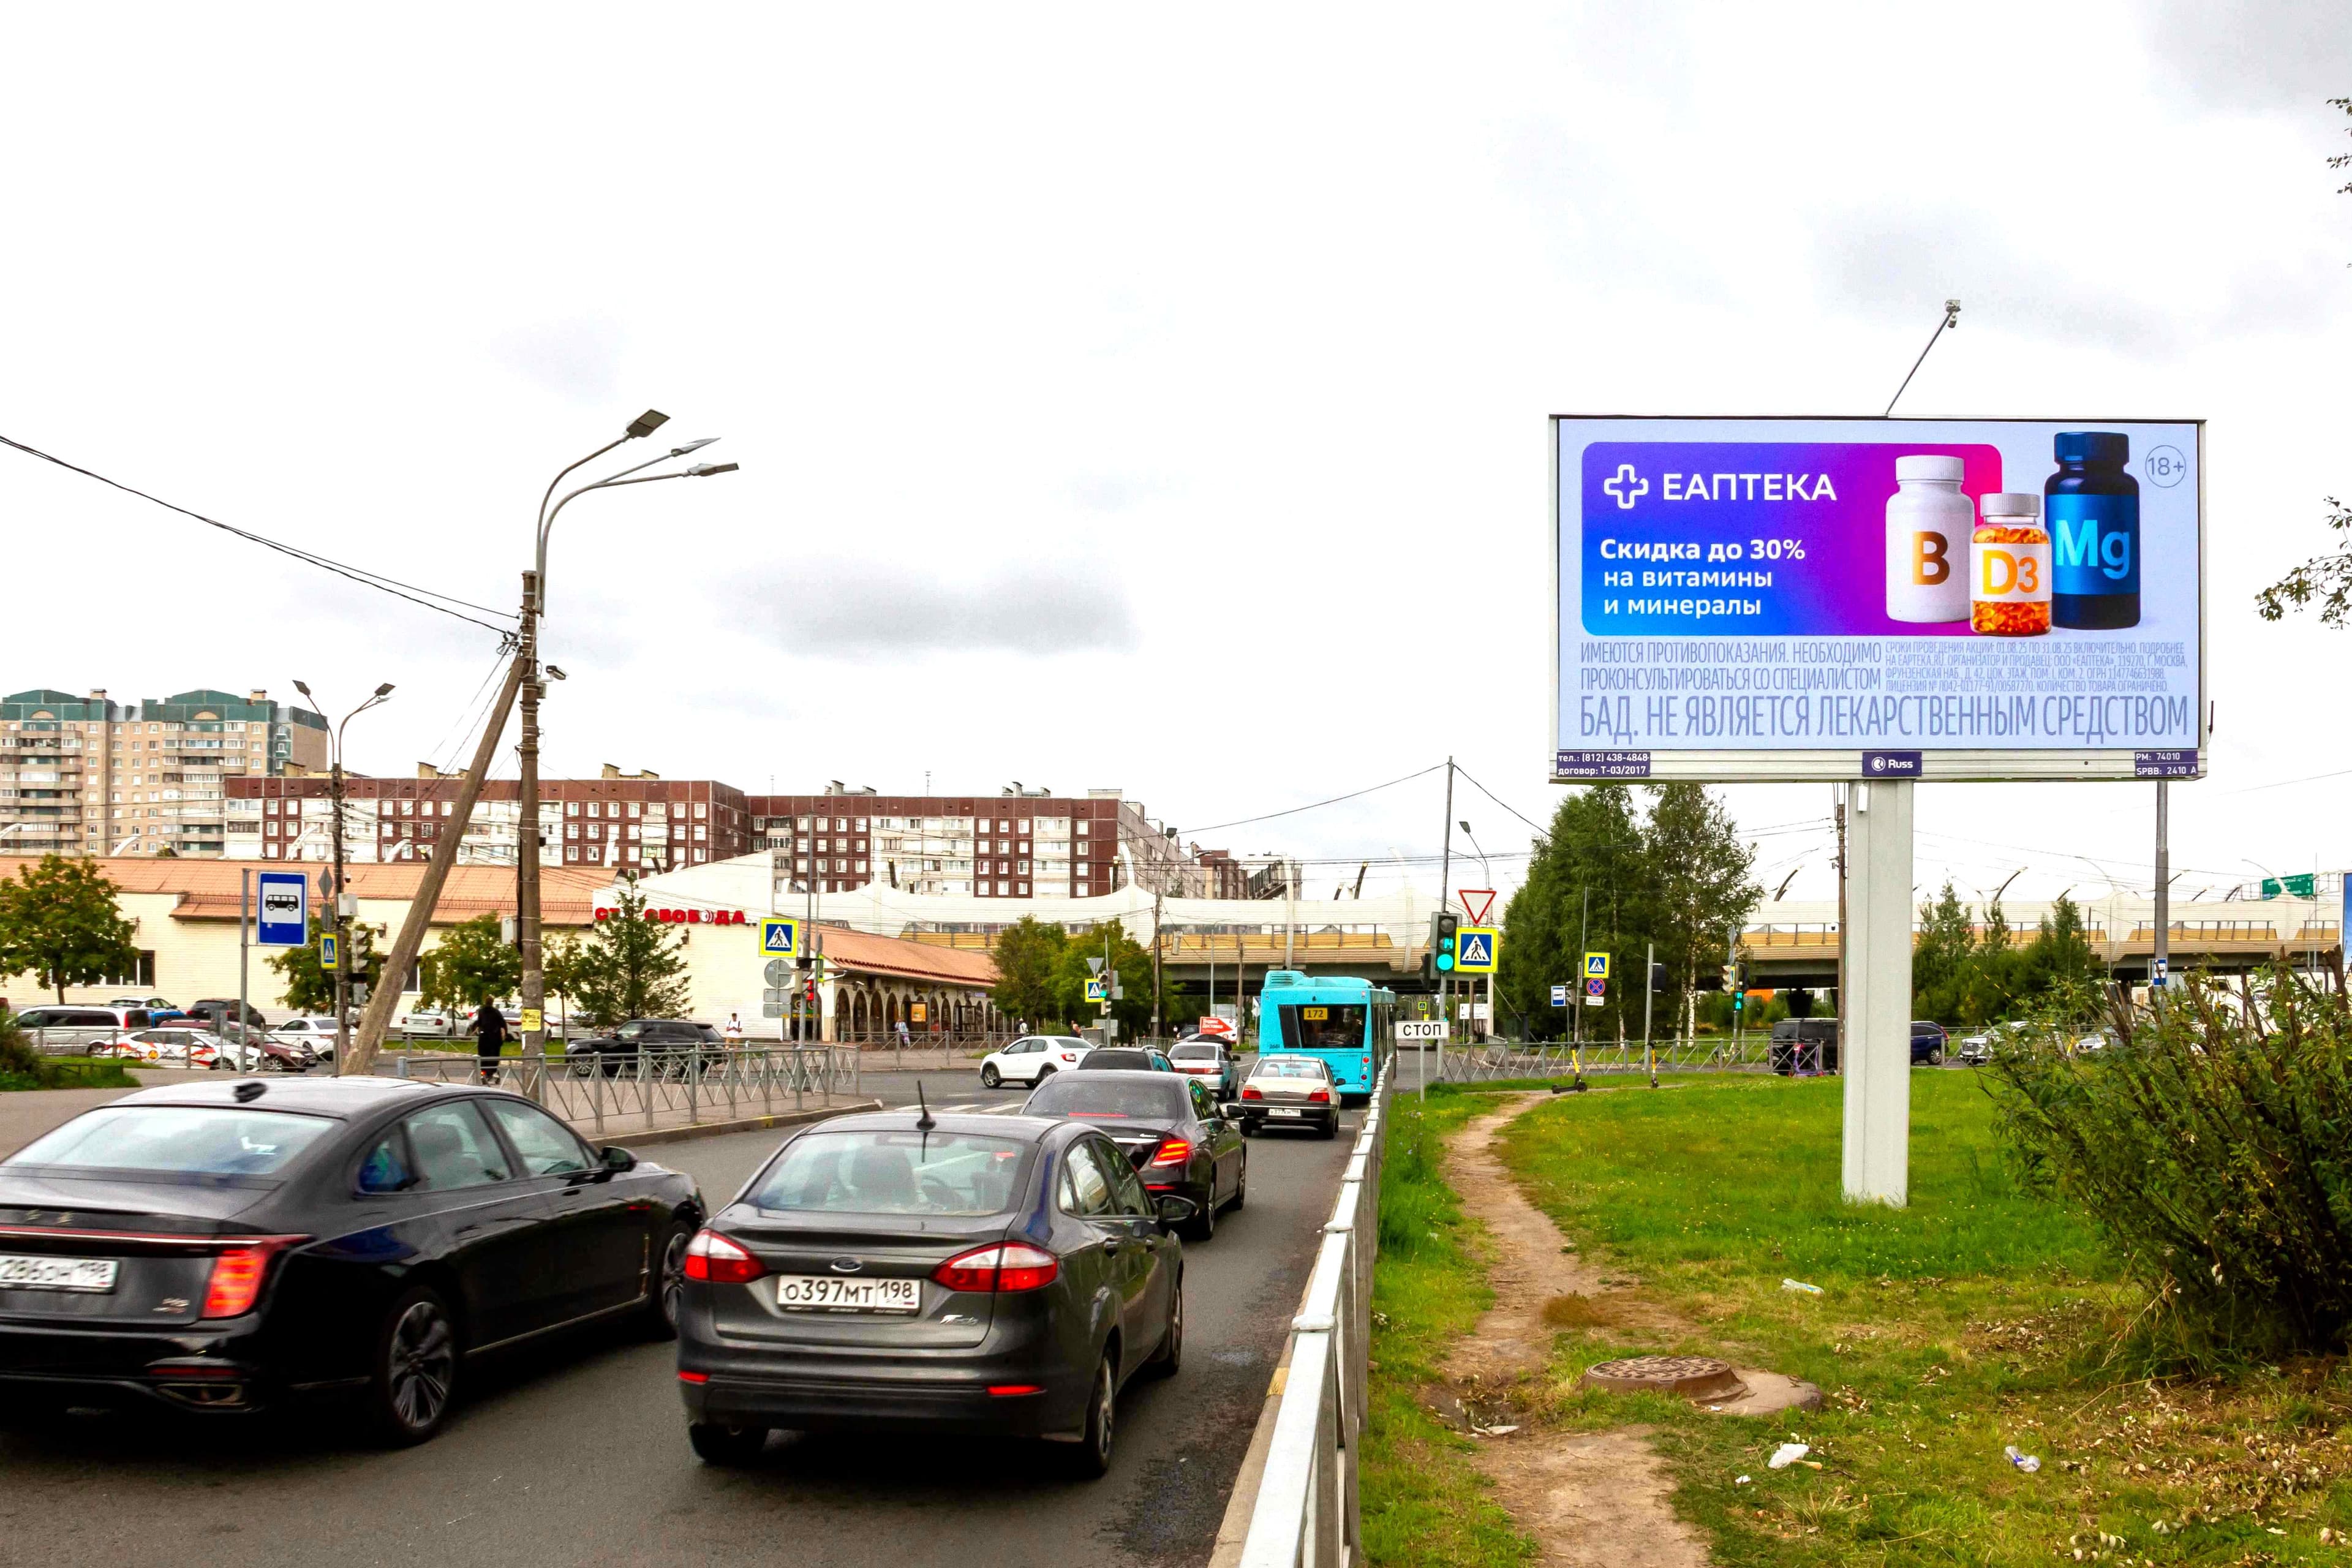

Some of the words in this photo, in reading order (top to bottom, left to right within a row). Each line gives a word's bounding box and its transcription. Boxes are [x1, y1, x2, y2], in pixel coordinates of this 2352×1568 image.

[2147, 457, 2184, 476] 18+
[1663, 473, 1837, 500] ЕАПТЕКА
[1600, 539, 1700, 562] Скидка
[1708, 543, 1742, 562] до
[1750, 539, 1806, 560] 30%
[1912, 530, 1950, 585] B
[2055, 519, 2130, 581] Mg
[1604, 571, 1634, 587] на
[1643, 571, 1772, 587] витамины
[1982, 549, 2038, 595] D3
[1604, 599, 1619, 614] и
[1627, 599, 1762, 619] минералы
[1581, 642, 1643, 663] ИМЕЮТСЯ
[1647, 642, 1789, 663] ПРОТИВОПОКАЗАНИЯ.
[1793, 642, 1881, 667] НЕОБХОДИМО
[1886, 642, 1911, 654] СРОКИ
[1913, 642, 1964, 655] ПРОВЕДЕНИЯ
[2029, 642, 2040, 654] ПО
[2139, 642, 2185, 656] ПОДРОБНЕЕ
[1886, 654, 1897, 666] НА
[1948, 654, 2000, 666] ОРГАНИЗАТОР
[2002, 655, 2008, 666] И
[2054, 655, 2070, 667] ООО
[1886, 667, 1942, 679] ФРУНЗЕНСКАЯ
[2087, 668, 2106, 679] ОГРН
[1581, 668, 1750, 690] ПРОКОНСУЛЬТИРОВАТЬСЯ
[1754, 668, 1770, 690] СО
[1773, 668, 1881, 695] СПЕЦИАЛИСТОМ
[1886, 680, 1927, 693] ЛИЦЕНЗИЯ
[2037, 680, 2086, 692] КОЛИЧЕСТВО
[2088, 680, 2116, 692] ТОВАРА
[1580, 696, 1638, 745] БАД.
[1646, 696, 1678, 736] НЕ
[1685, 696, 1809, 736] ЯВЛЯЕТСЯ
[1817, 696, 2035, 736] ЛЕКАРСТВЕННЫМ
[2043, 695, 2187, 744] СРЕДСТВОМ
[1582, 753, 1604, 763] (812)
[1606, 753, 1648, 762] 438-4848
[1888, 759, 1913, 769] Russ
[2156, 752, 2180, 761] 74010
[1558, 767, 1598, 776] договор:
[1600, 766, 1646, 775] Т-03/2017
[2136, 767, 2162, 775] SPBB:
[2166, 766, 2187, 775] 2410
[2190, 766, 2197, 774] A
[1307, 1009, 1324, 1018] 172
[1403, 1024, 1441, 1036] СТОП
[785, 1279, 873, 1303] О397МТ
[878, 1281, 913, 1298] 198
